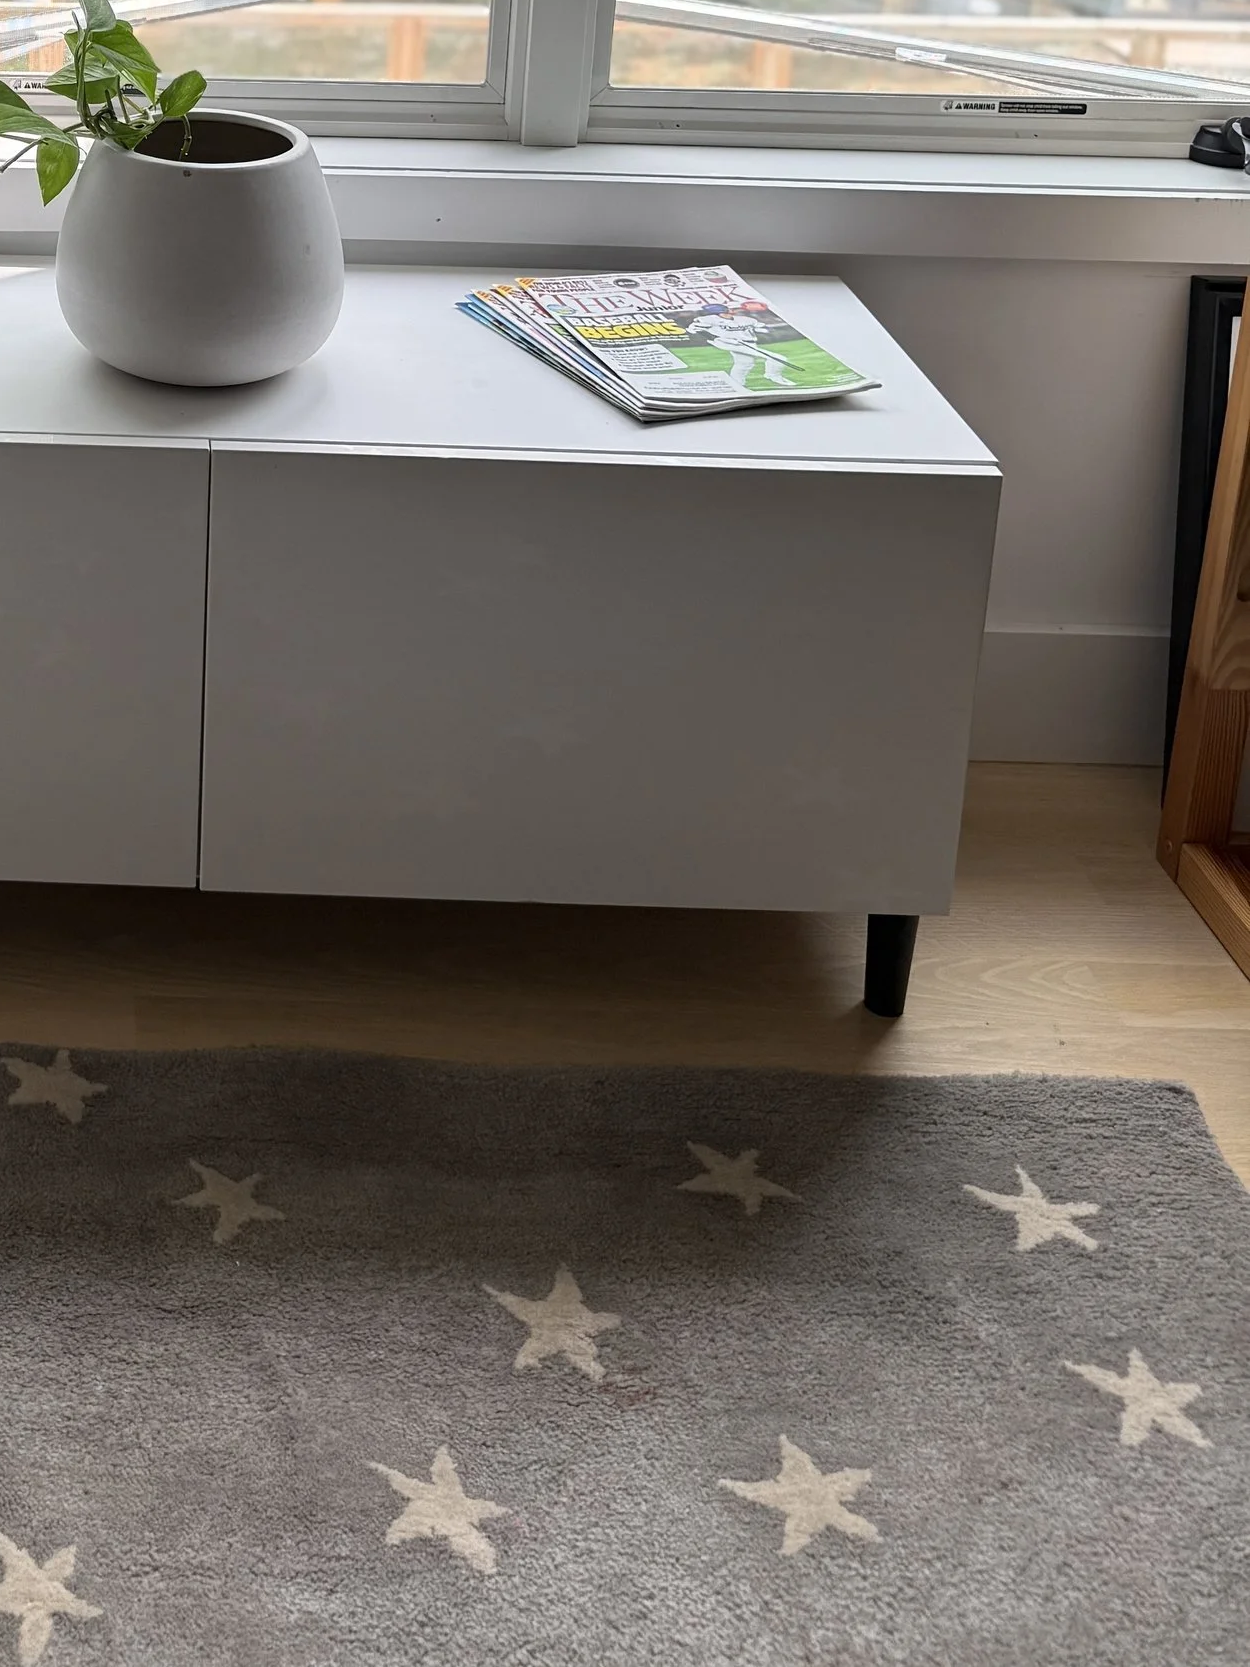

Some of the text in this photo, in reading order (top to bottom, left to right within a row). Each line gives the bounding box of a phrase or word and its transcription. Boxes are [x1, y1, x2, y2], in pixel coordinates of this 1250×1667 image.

[539, 291, 634, 313] THE
[626, 286, 757, 306] WEEK
[636, 304, 685, 312] Junior
[569, 313, 675, 326] BASEBALL
[574, 322, 688, 339] BEGINS
